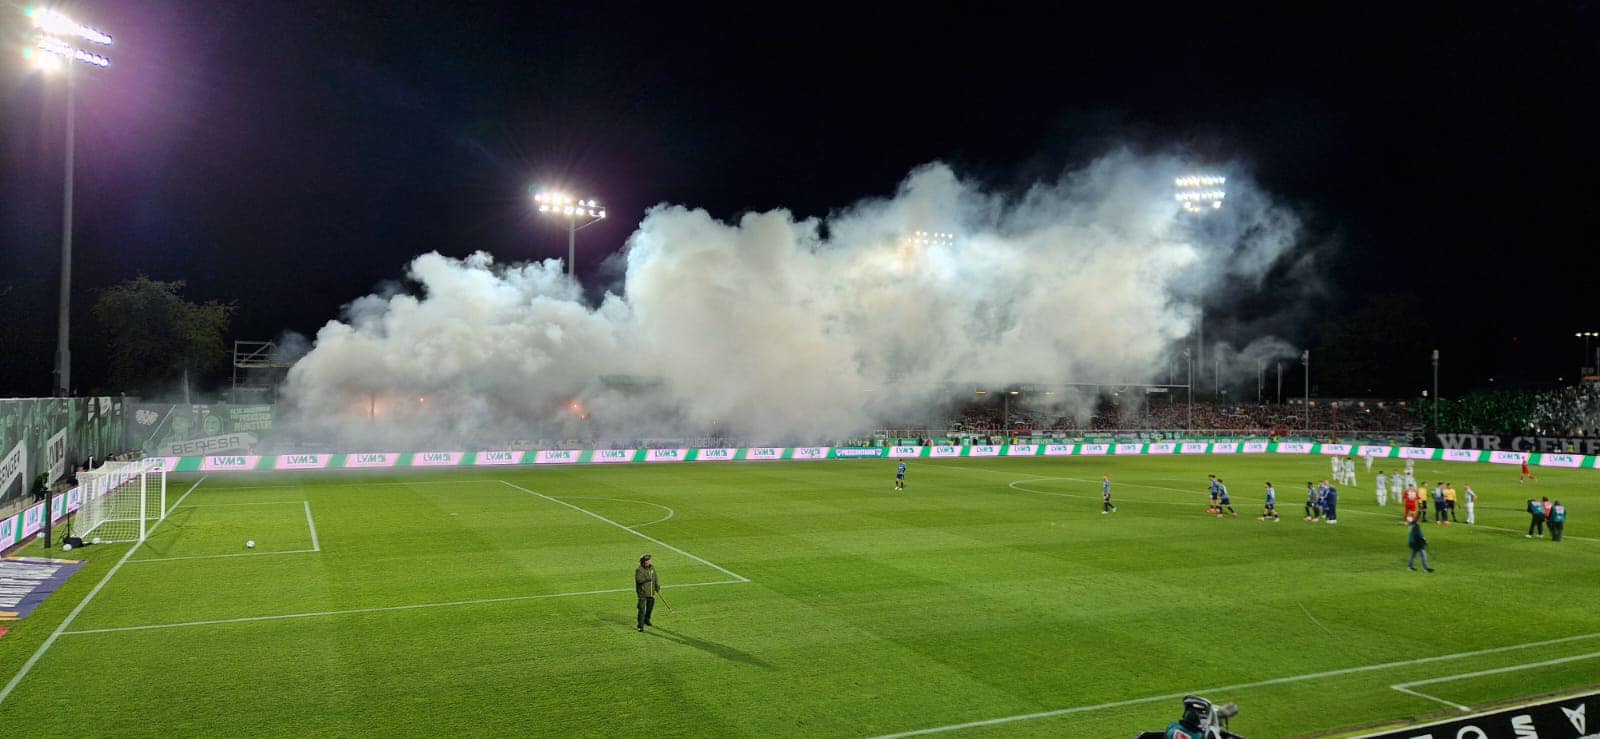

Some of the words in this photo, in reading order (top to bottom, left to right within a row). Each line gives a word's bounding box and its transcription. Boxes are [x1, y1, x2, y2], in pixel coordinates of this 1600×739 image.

[171, 437, 240, 455] BERESA
[1437, 433, 1501, 450] WIR
[0, 449, 21, 487] ENGER
